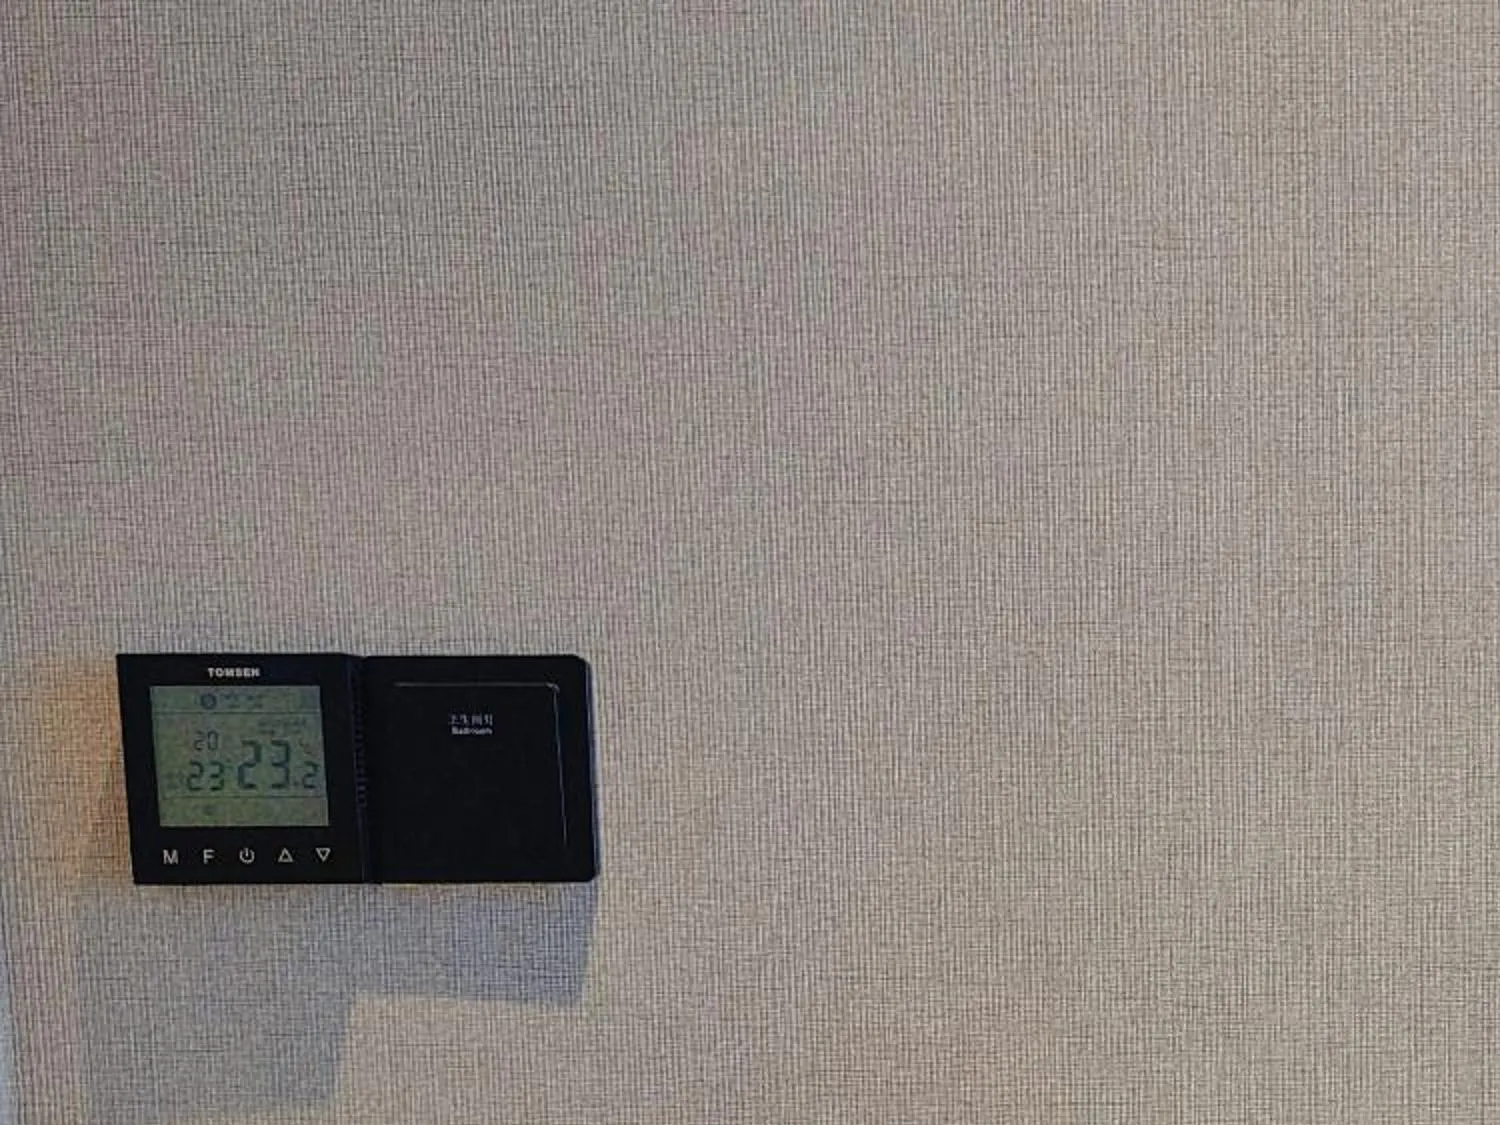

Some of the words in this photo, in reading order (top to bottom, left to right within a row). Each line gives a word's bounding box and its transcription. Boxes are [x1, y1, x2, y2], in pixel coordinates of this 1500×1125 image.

[186, 760, 225, 791] 23
[162, 849, 179, 865] M
[203, 849, 215, 865] F
